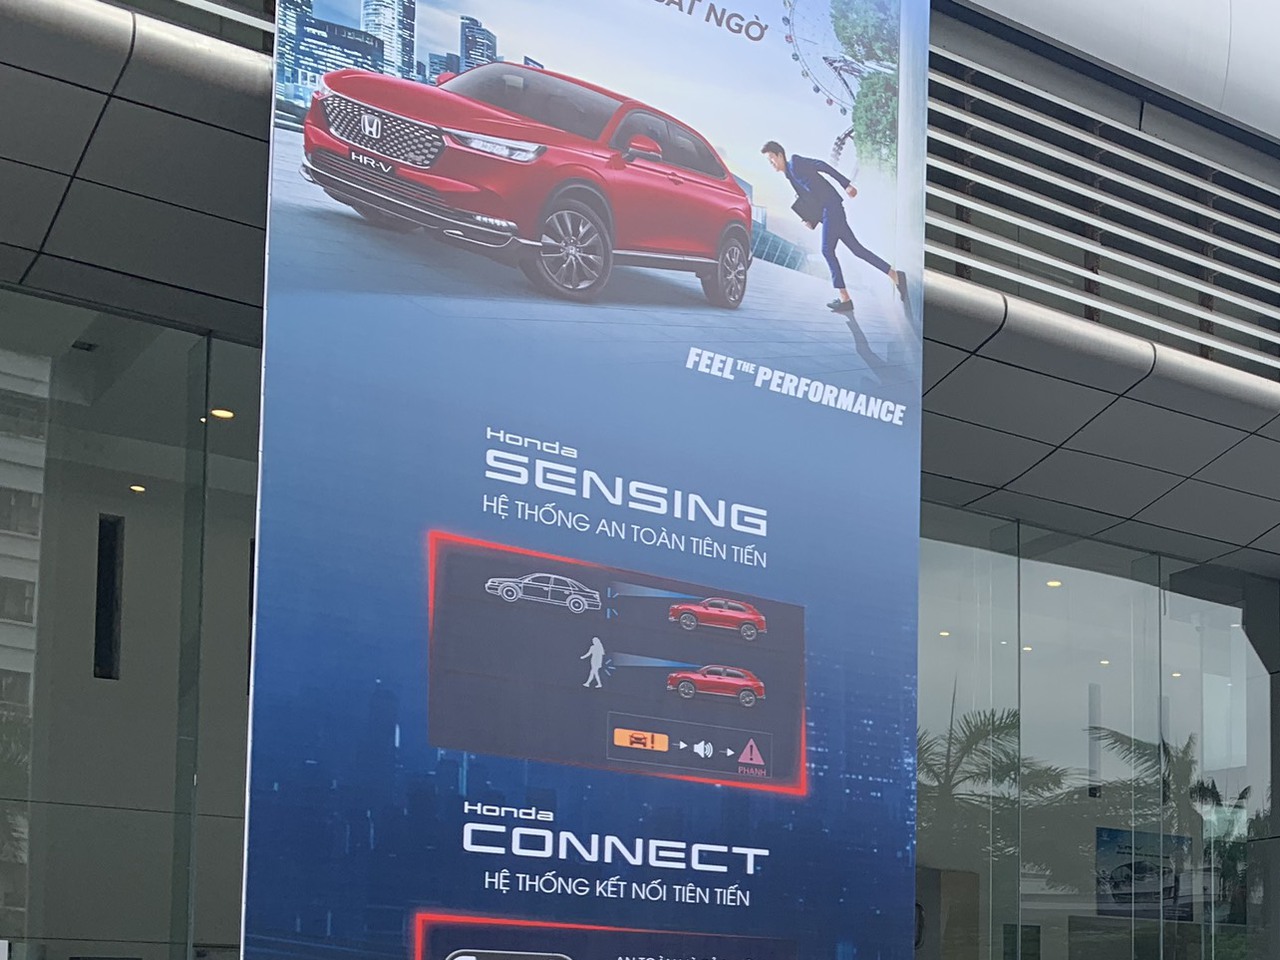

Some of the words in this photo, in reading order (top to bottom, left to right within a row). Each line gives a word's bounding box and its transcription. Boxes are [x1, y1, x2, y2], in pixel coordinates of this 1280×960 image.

[704, 2, 769, 41] NGỜ
[351, 151, 392, 173] HR-V
[685, 347, 735, 380] FEEL
[736, 359, 757, 375] THE
[754, 365, 907, 426] PERFORMANCE
[486, 426, 578, 459] Honda
[485, 448, 768, 537] SENSING
[482, 494, 509, 519] HỆ
[514, 501, 591, 532] THỐNG
[595, 518, 626, 540] AN
[630, 524, 685, 551] TOÀN
[689, 536, 727, 560] TIÊN
[731, 544, 767, 568] TIẾN
[738, 766, 767, 777] PHANH
[464, 801, 554, 822] Honda
[463, 822, 770, 875] CONNECT
[484, 869, 511, 894] HỆ
[515, 870, 590, 896] THỐNG
[595, 875, 627, 898] KẾT
[631, 879, 667, 901] NỐI
[672, 883, 710, 904] TIÊN
[713, 884, 750, 906] TIẾN
